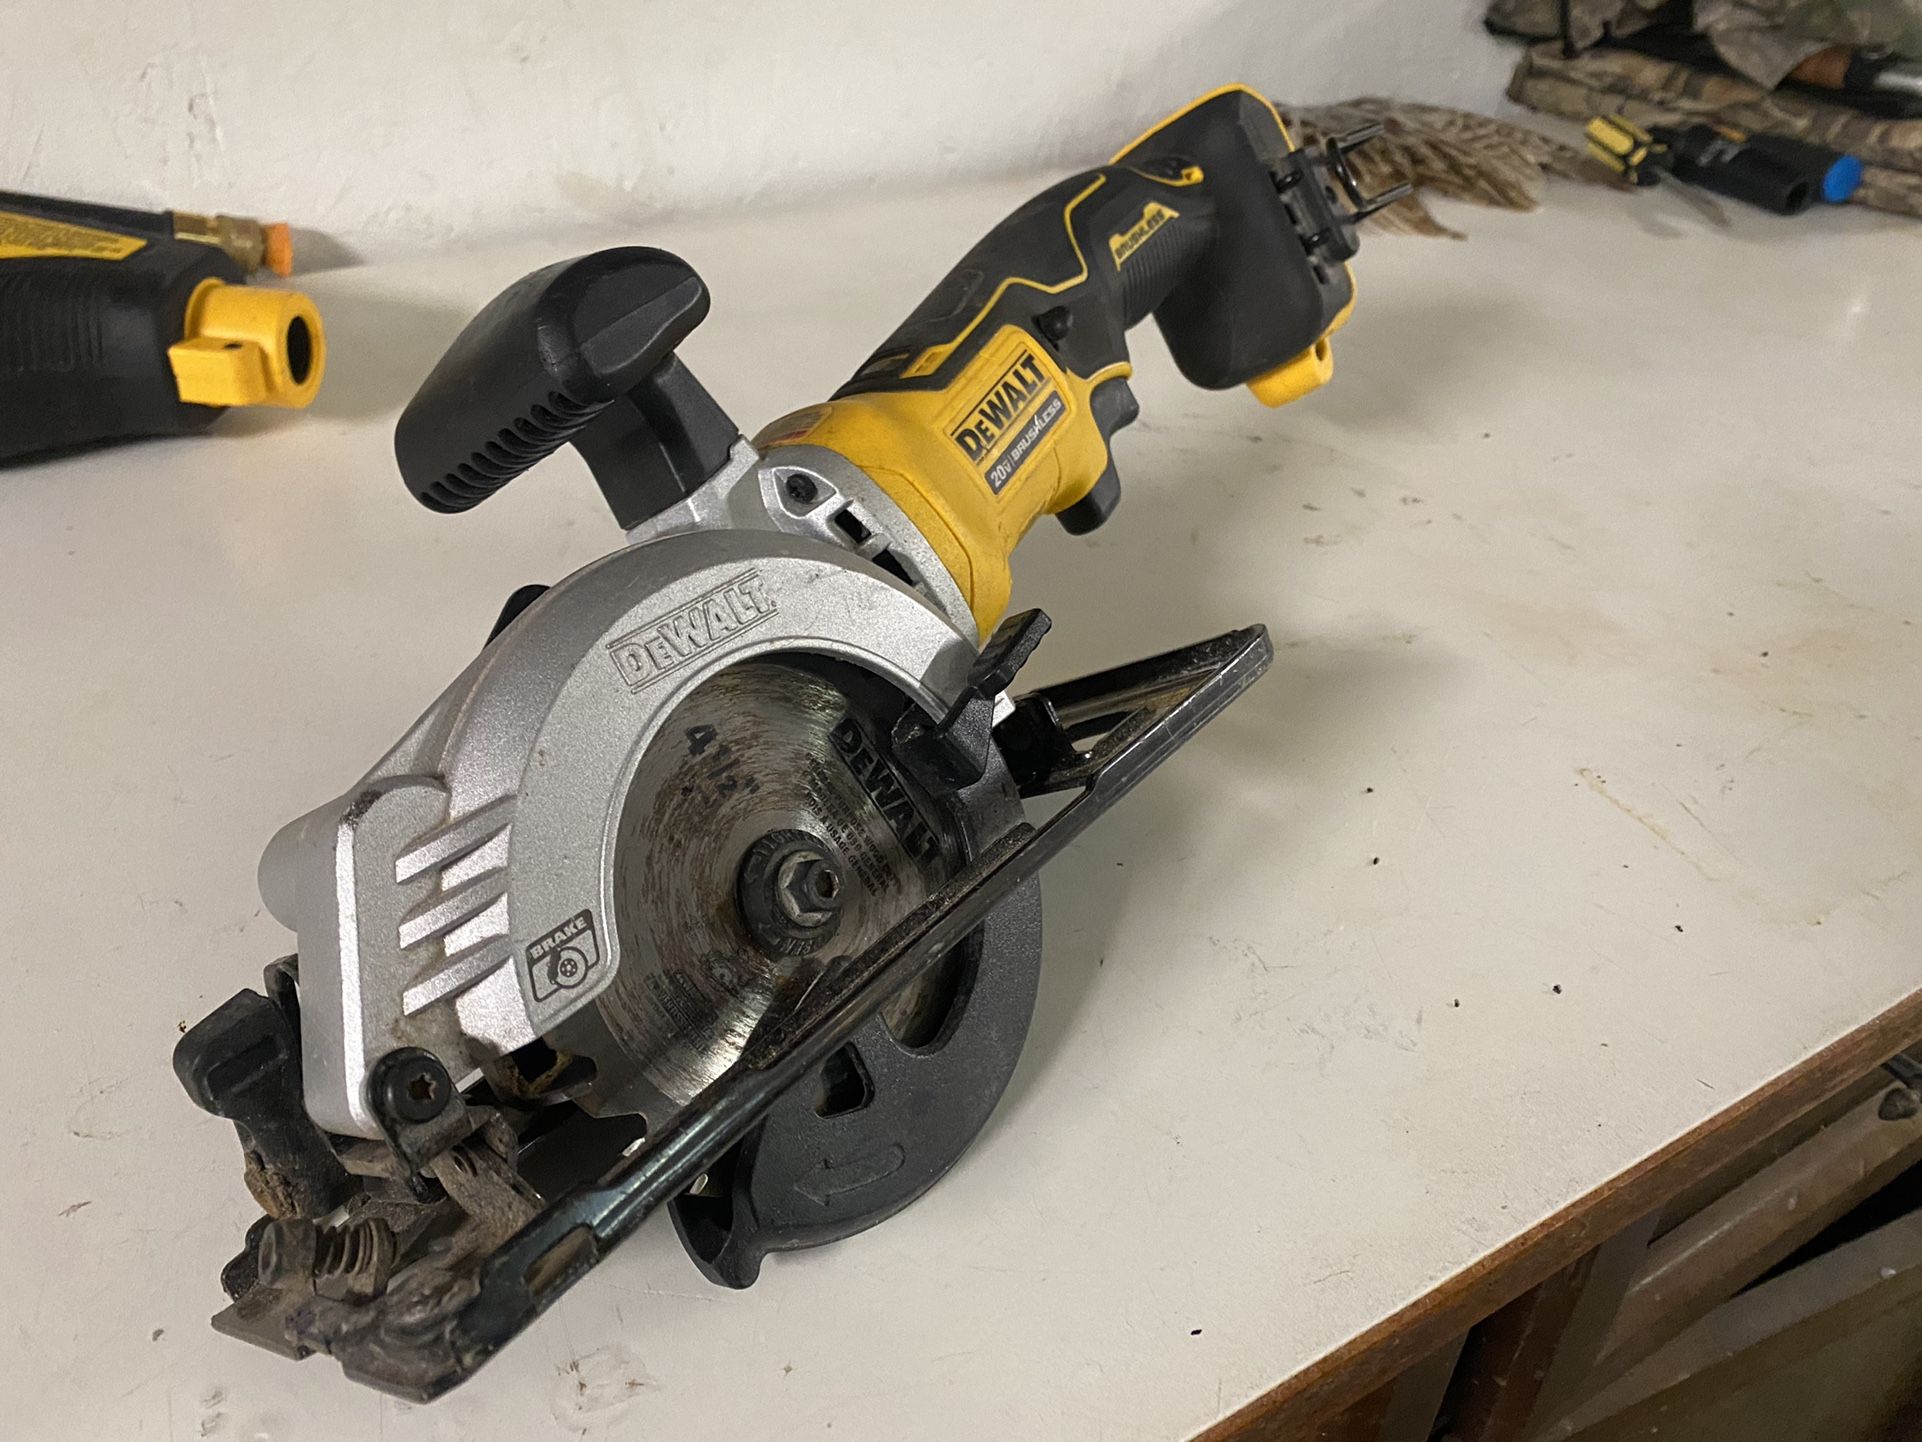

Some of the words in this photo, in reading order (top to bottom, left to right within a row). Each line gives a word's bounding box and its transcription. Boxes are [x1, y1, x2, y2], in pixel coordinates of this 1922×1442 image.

[954, 353, 1046, 463] DEWALT
[1012, 397, 1062, 461] BRUSHLESS
[609, 576, 771, 687] DEWALT
[829, 716, 943, 869] DEWALT
[529, 916, 588, 960] BRAKE
